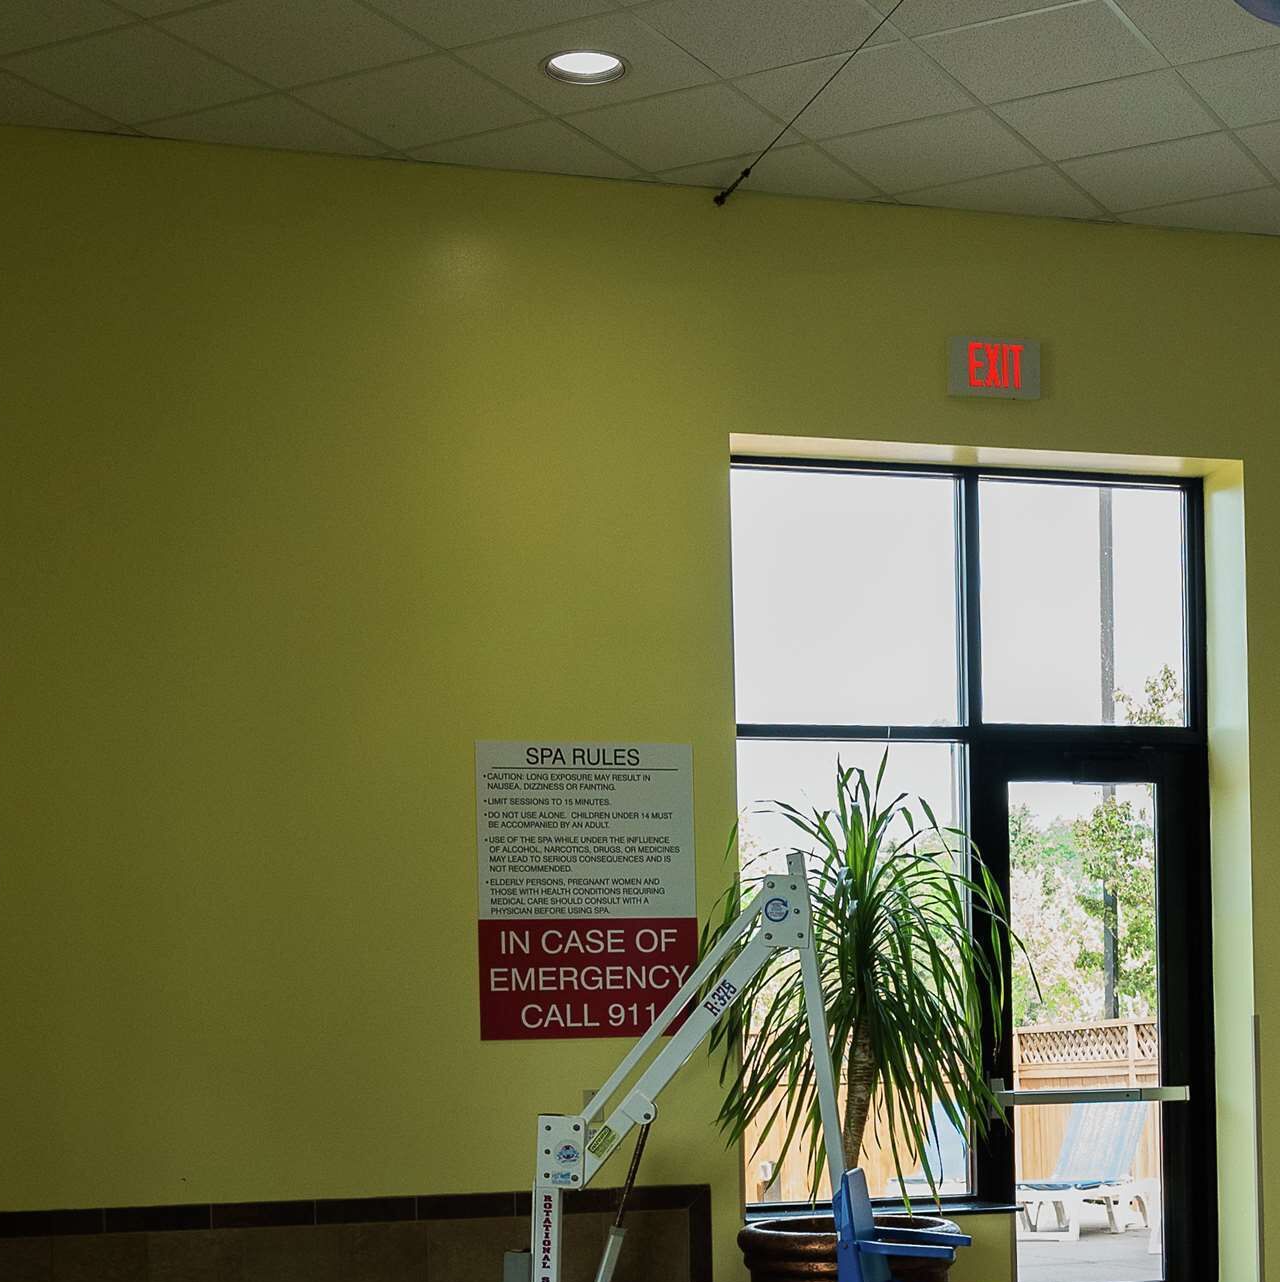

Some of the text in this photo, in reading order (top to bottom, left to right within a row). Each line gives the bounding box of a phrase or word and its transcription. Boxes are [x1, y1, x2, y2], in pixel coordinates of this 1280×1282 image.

[968, 341, 1024, 390] EXIT
[526, 748, 639, 766] SPA RULES
[500, 929, 678, 954] IN CASE OF
[490, 966, 689, 992] EMERGENCY
[521, 1004, 656, 1028] CALL 911
[542, 1195, 552, 1269] ROTATIONAL
